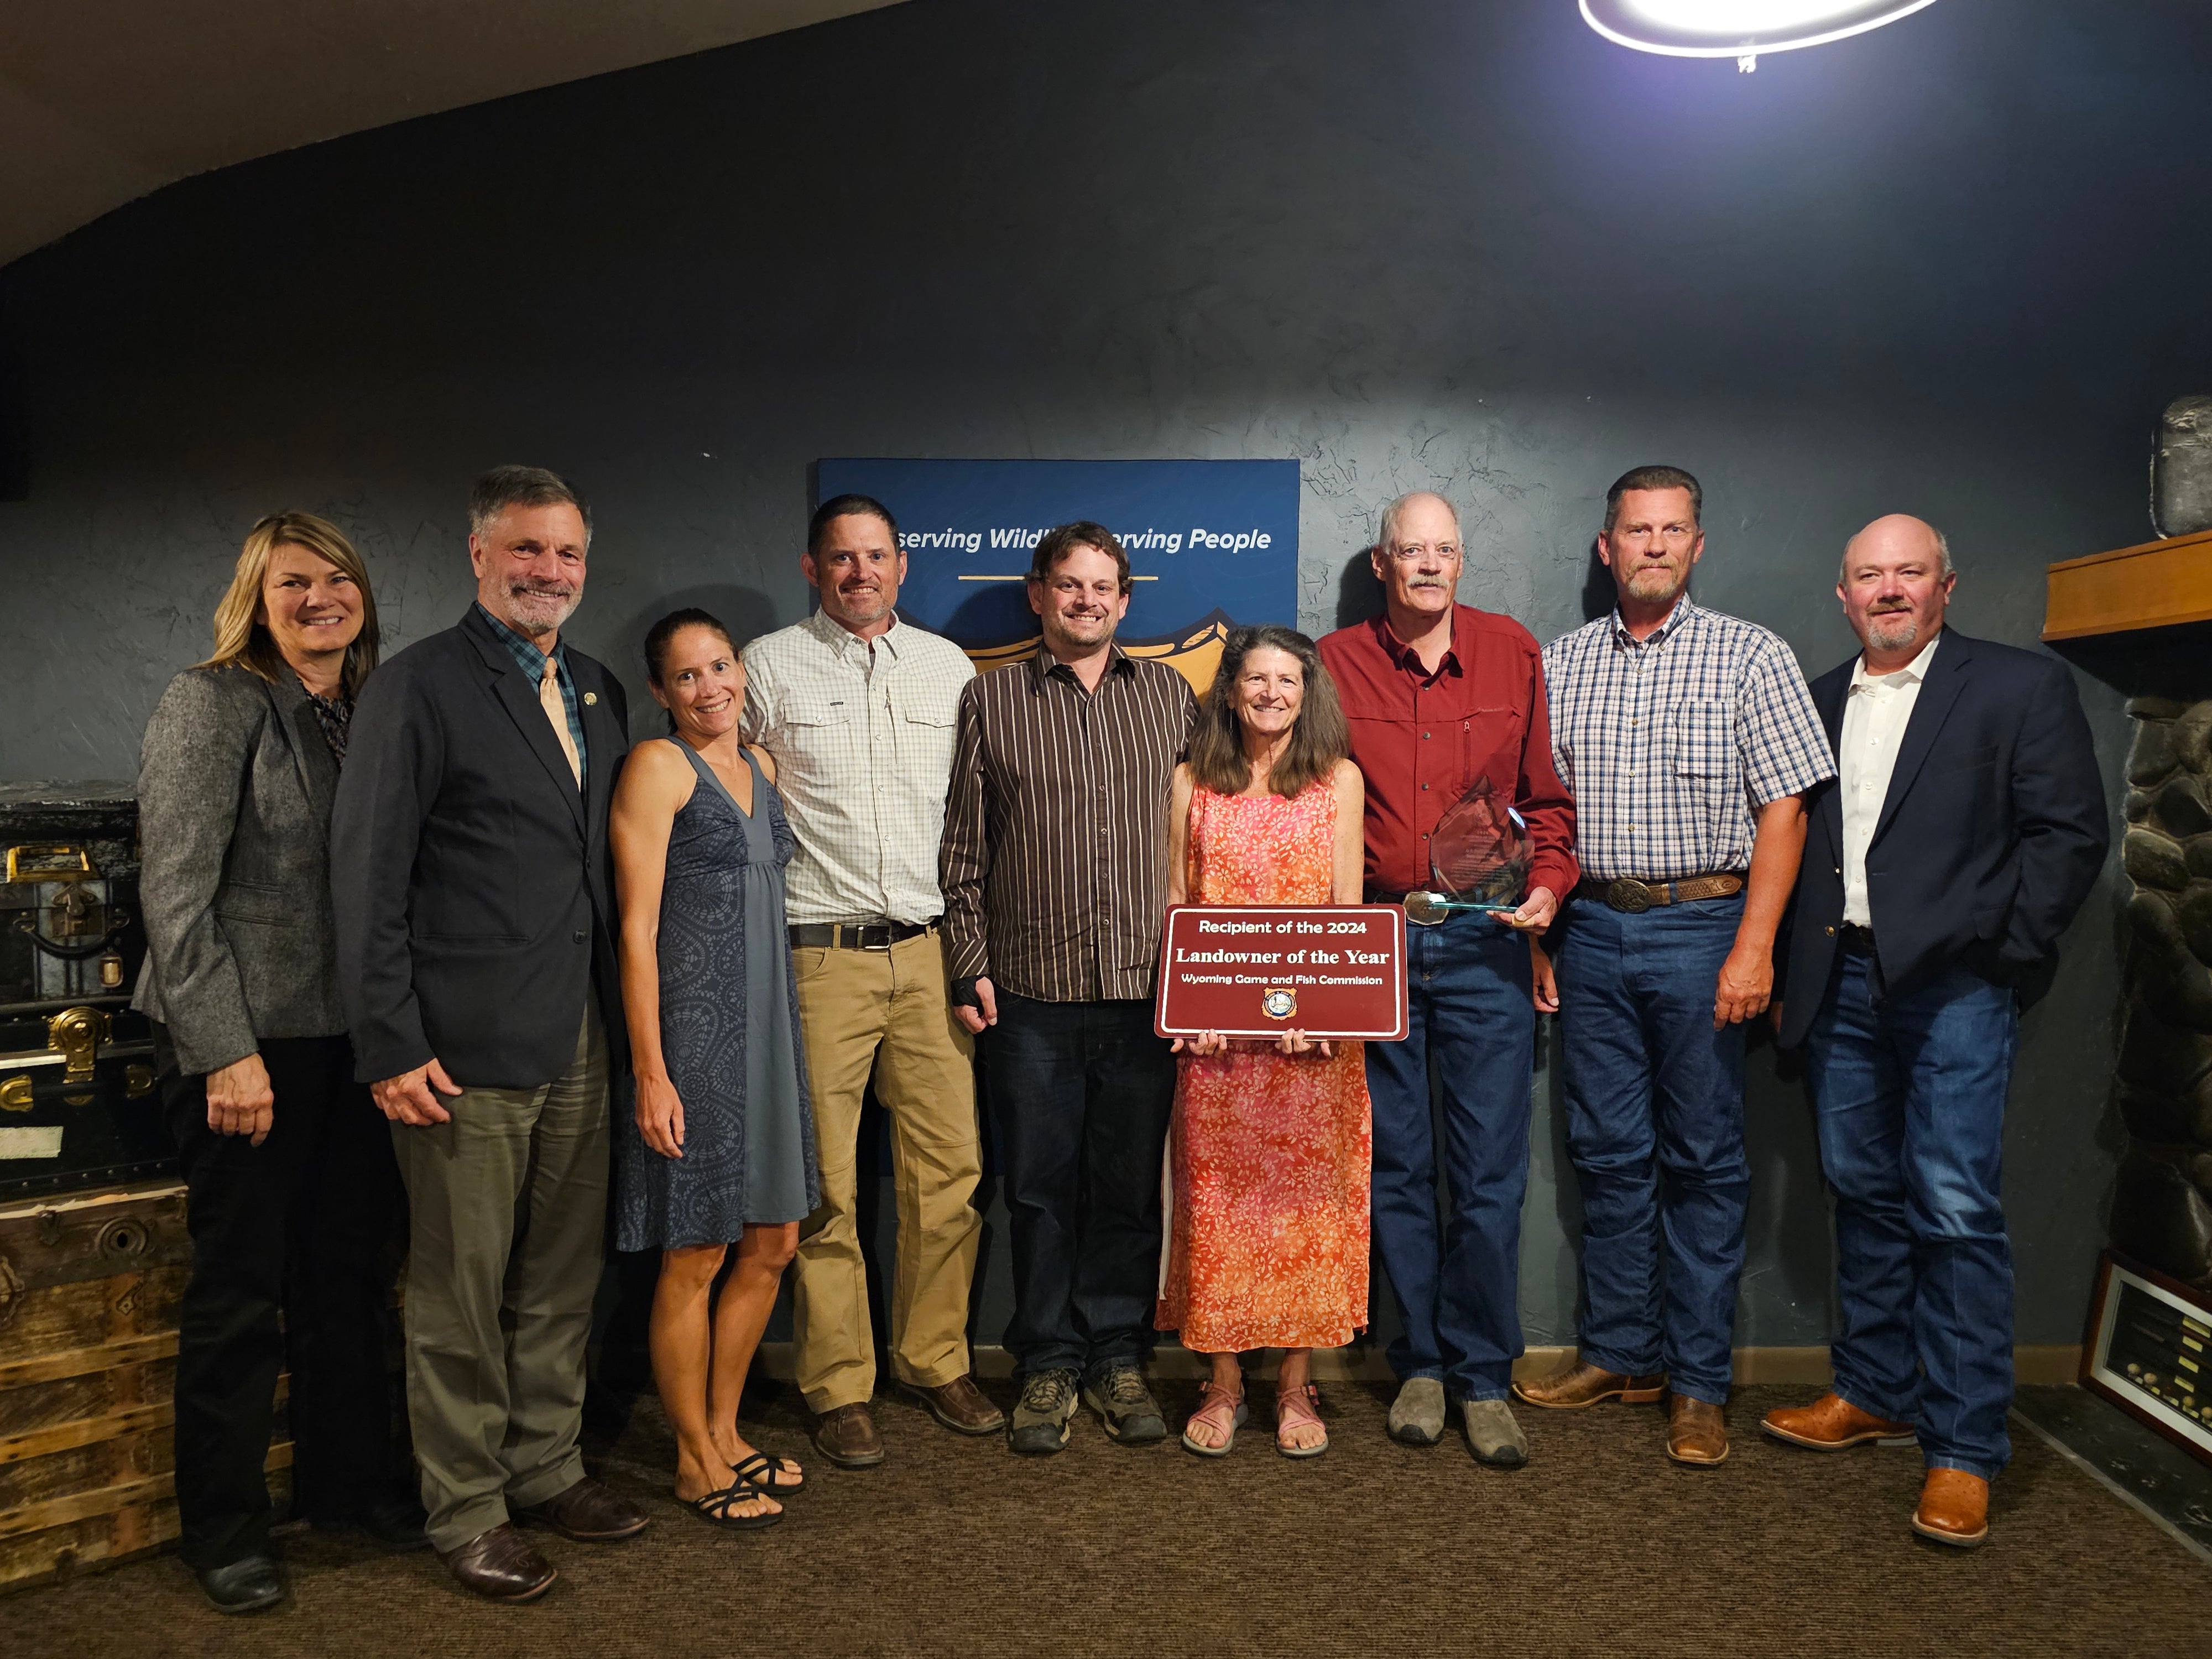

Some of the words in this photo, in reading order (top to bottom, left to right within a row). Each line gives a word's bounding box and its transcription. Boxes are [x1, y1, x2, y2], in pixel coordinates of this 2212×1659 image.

[898, 528, 982, 555] serving
[1188, 528, 1271, 554] People
[1199, 920, 1272, 936] Recipient
[1276, 920, 1293, 933] of
[1296, 921, 1323, 933] the
[1327, 922, 1368, 934] 2024
[1175, 948, 1282, 963] Landowner
[1287, 949, 1307, 964] of
[1310, 950, 1339, 964] the
[1344, 950, 1390, 964] Year
[1181, 973, 1232, 985] Wyoming
[1235, 974, 1269, 984] Game
[1271, 974, 1293, 984] and
[1295, 974, 1316, 984] Fish
[1318, 974, 1383, 985] Commission
